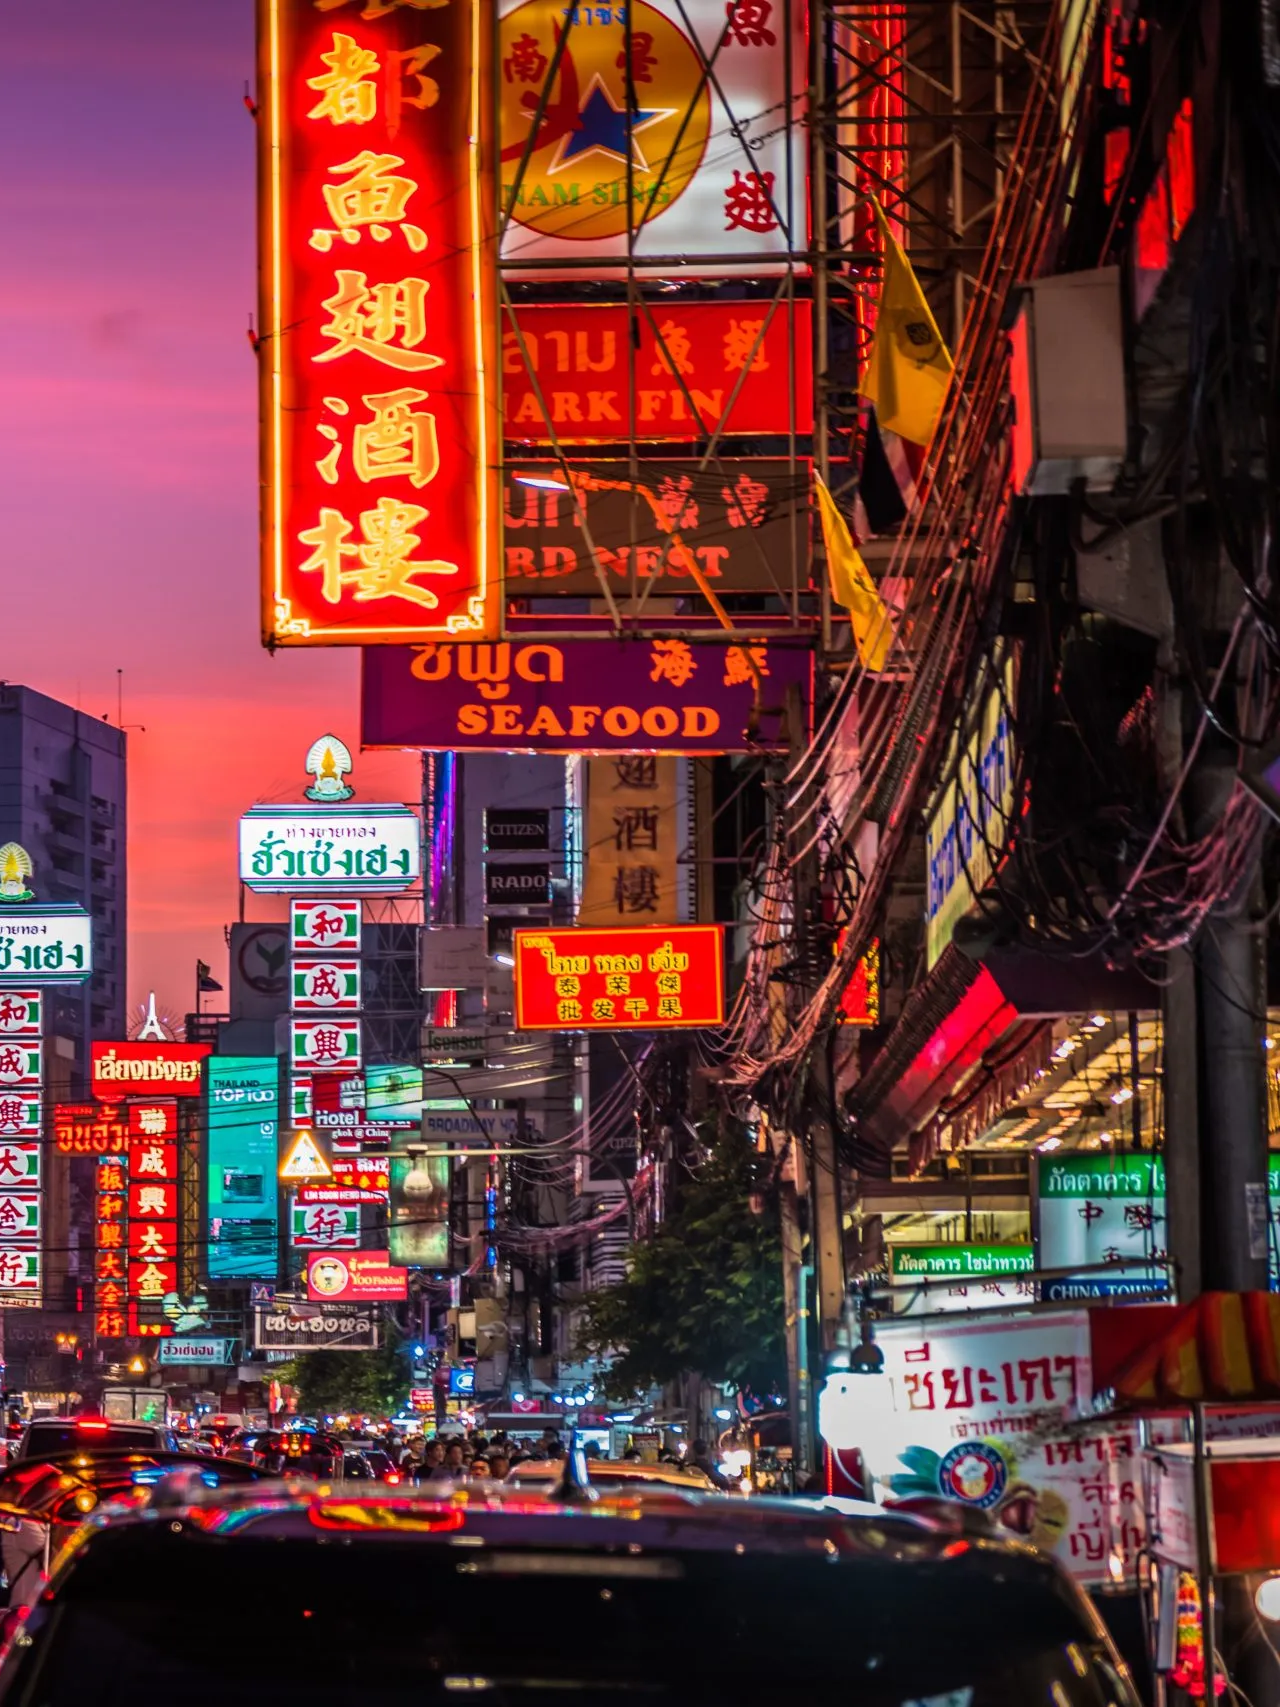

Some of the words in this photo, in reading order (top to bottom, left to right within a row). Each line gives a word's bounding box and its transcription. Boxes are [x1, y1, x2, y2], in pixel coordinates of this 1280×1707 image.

[502, 182, 580, 206] NAM
[591, 181, 670, 206] SING
[297, 0, 459, 609] 都魚翅酒樓
[637, 389, 724, 422] FIN
[593, 545, 730, 578] NEST
[457, 704, 719, 738] SEAFOOD
[489, 823, 546, 836] CITIZEN
[490, 875, 546, 889] RADO
[542, 947, 589, 974] ไทย
[214, 1080, 261, 1089] THAILAND
[427, 1116, 497, 1135] BROADWAY
[1047, 1167, 1142, 1193] ภัตตาคาร
